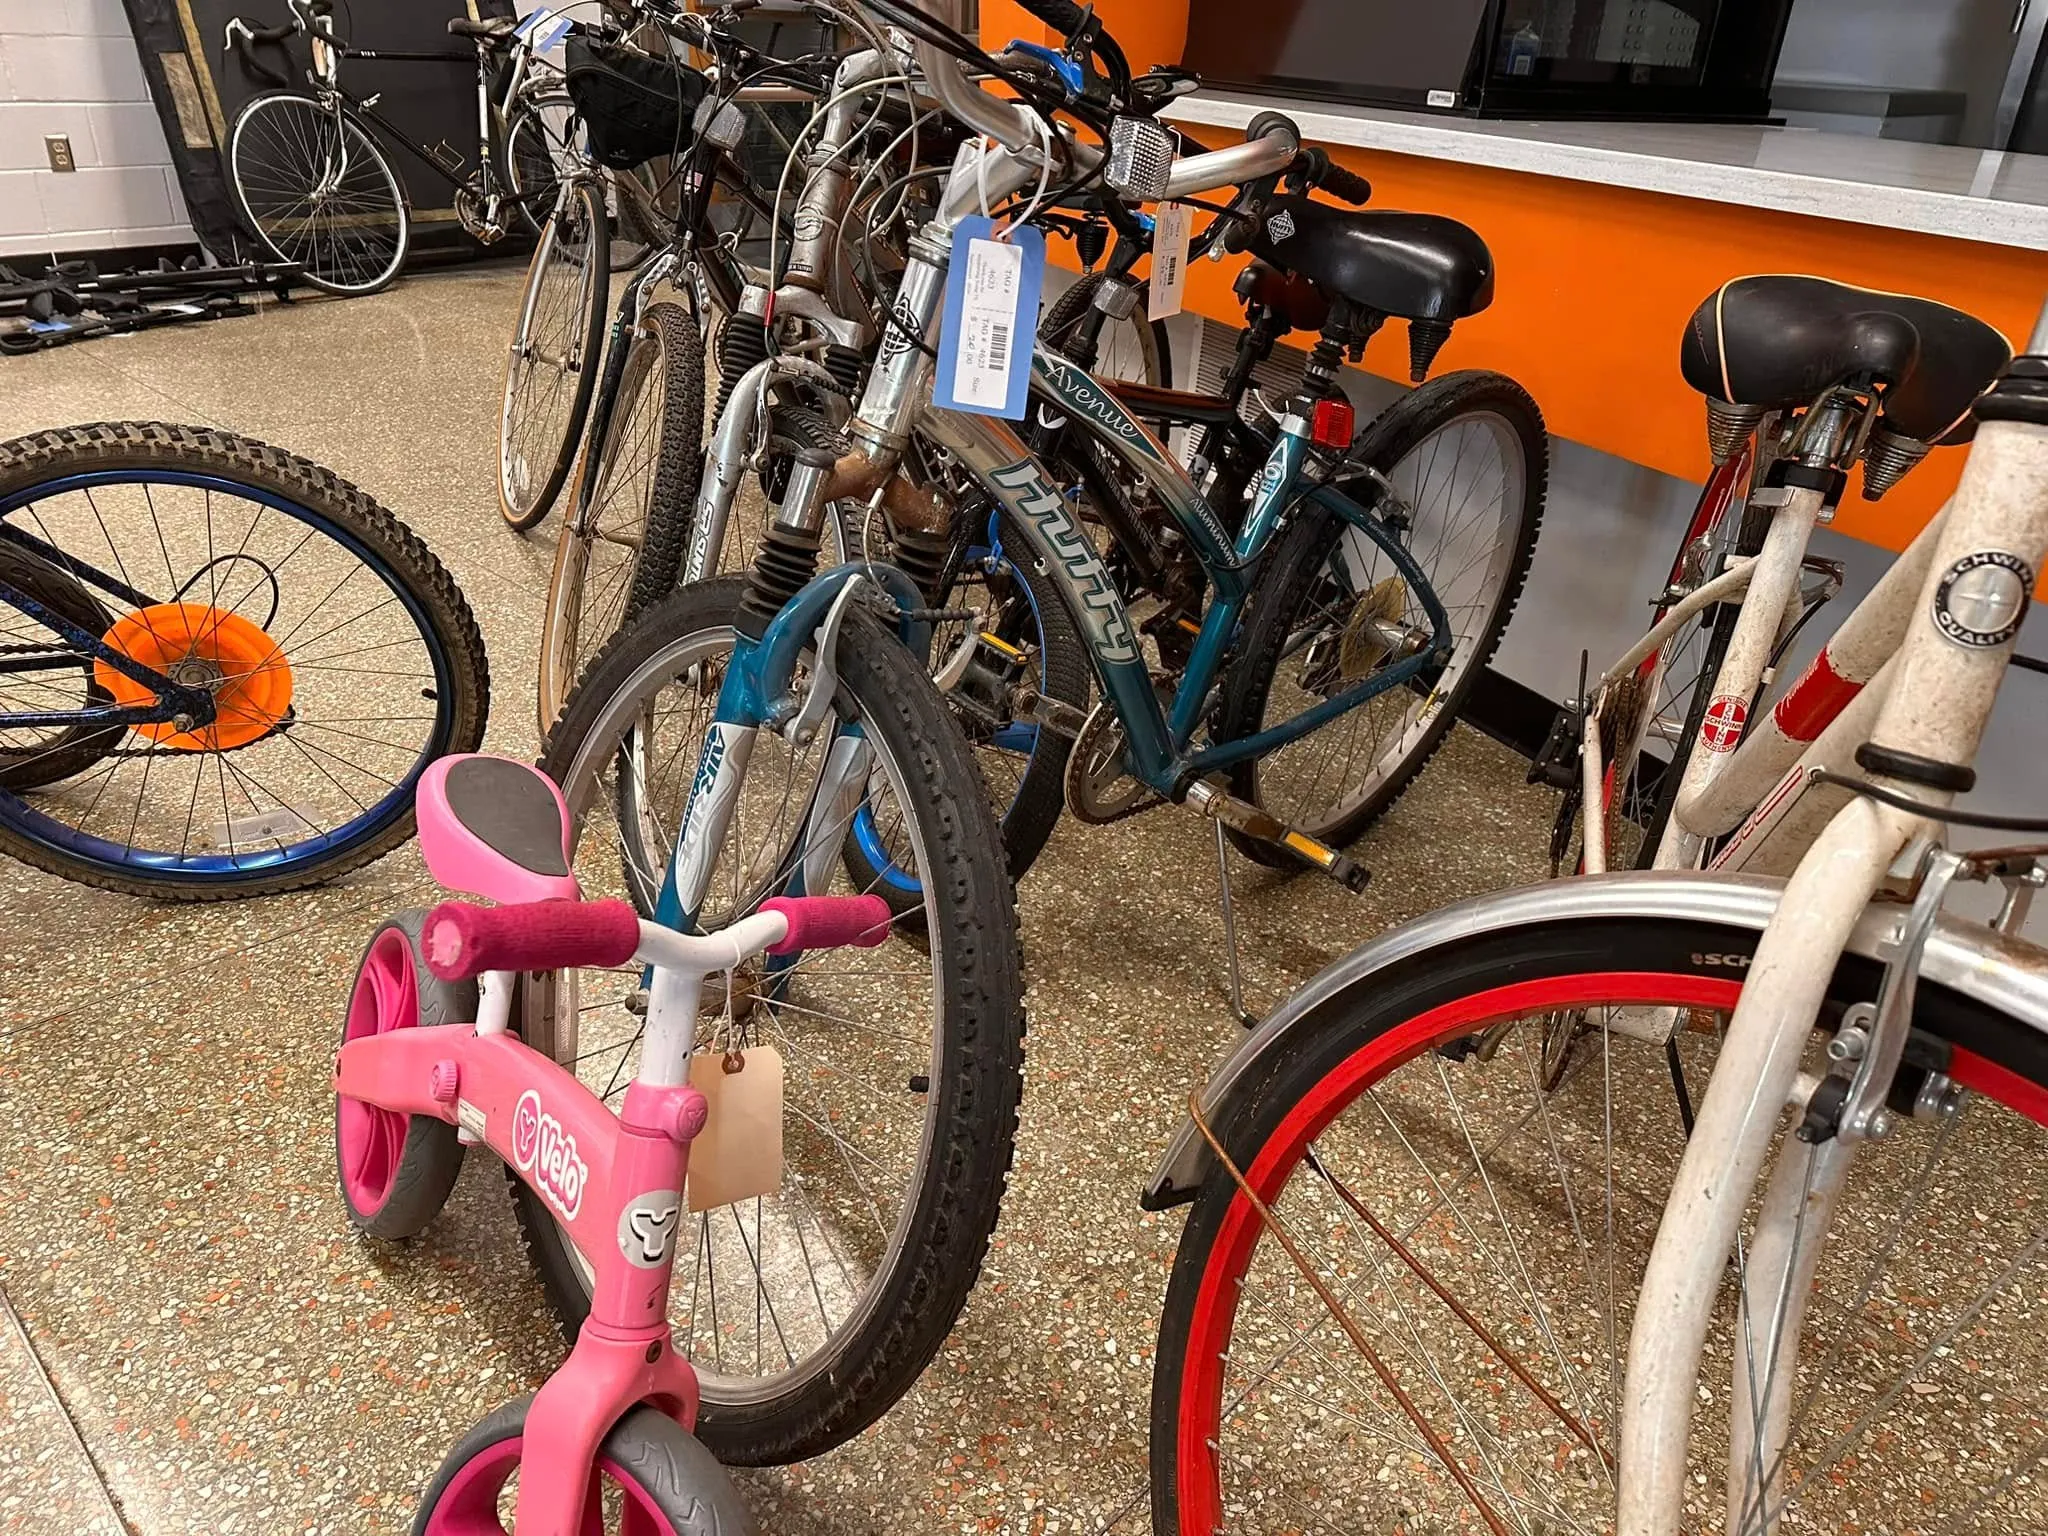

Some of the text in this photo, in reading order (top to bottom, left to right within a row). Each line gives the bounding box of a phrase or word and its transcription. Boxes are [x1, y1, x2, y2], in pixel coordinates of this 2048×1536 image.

[987, 269, 997, 290] 4623
[1003, 269, 1013, 287] TAG
[980, 318, 990, 336] TAG
[978, 347, 988, 370] 4623
[1045, 361, 1139, 439] Avenue
[1190, 497, 1239, 568] Aluminum
[1943, 553, 2034, 596] SCHWINN
[1940, 611, 2016, 645] QUALITY
[539, 1119, 580, 1211] Velo
